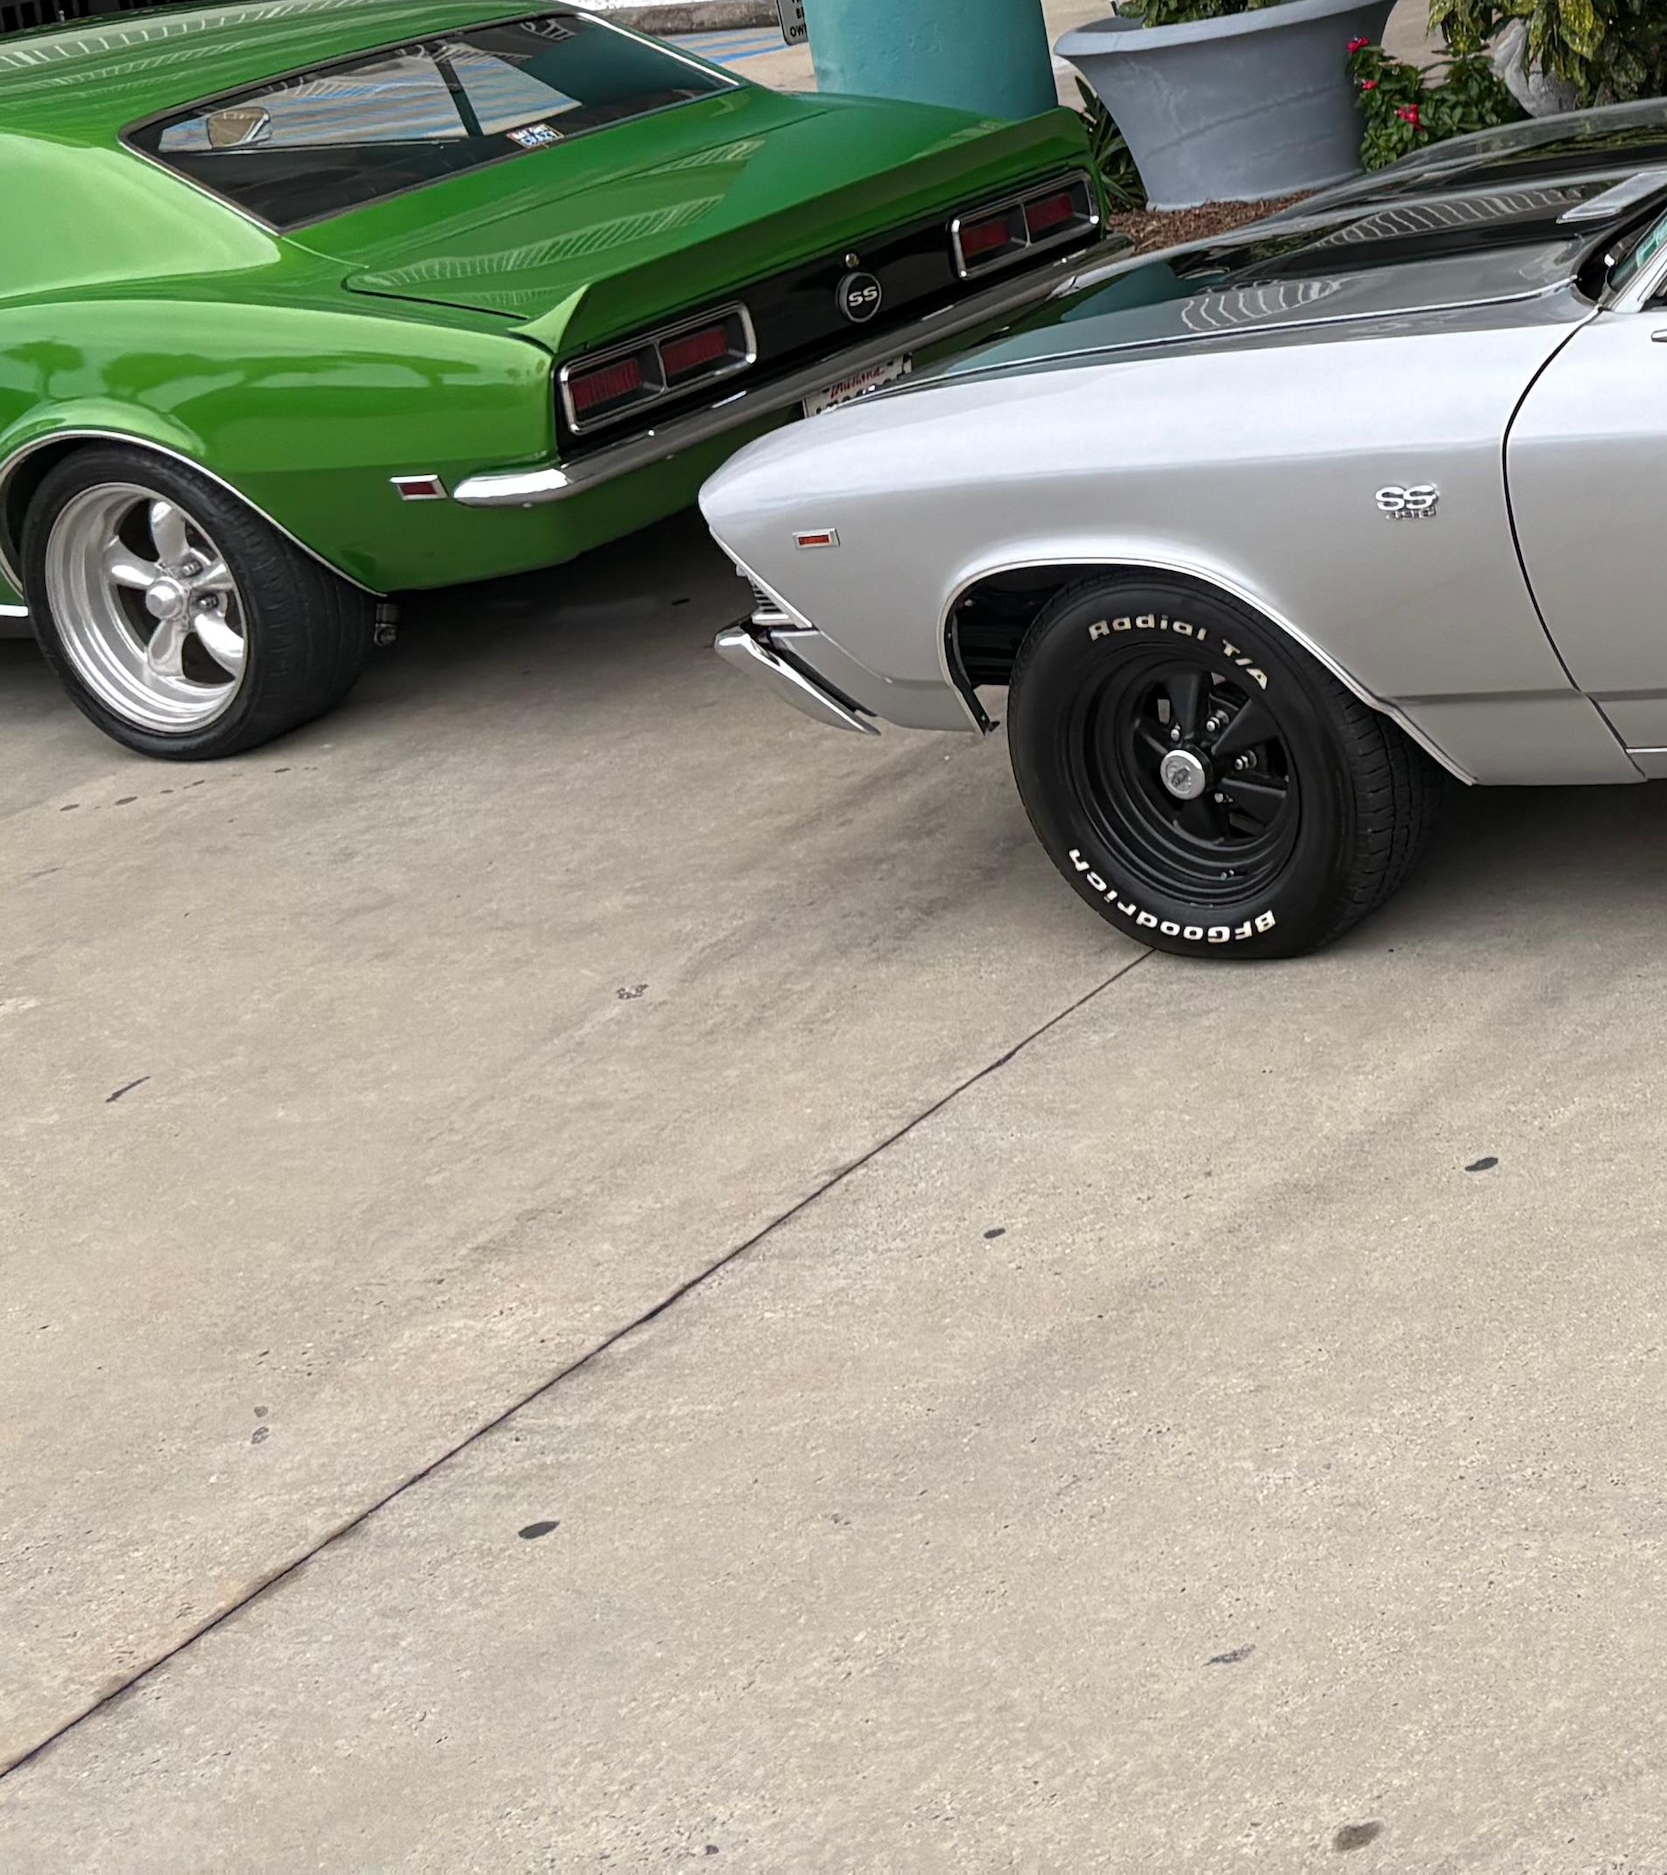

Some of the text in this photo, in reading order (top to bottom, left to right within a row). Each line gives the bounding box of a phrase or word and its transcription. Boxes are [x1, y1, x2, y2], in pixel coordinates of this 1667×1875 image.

[848, 285, 878, 307] SS
[1375, 484, 1437, 511] SS
[1087, 613, 1269, 691] Radial T/A
[1068, 847, 1277, 945] BFGoodrich
